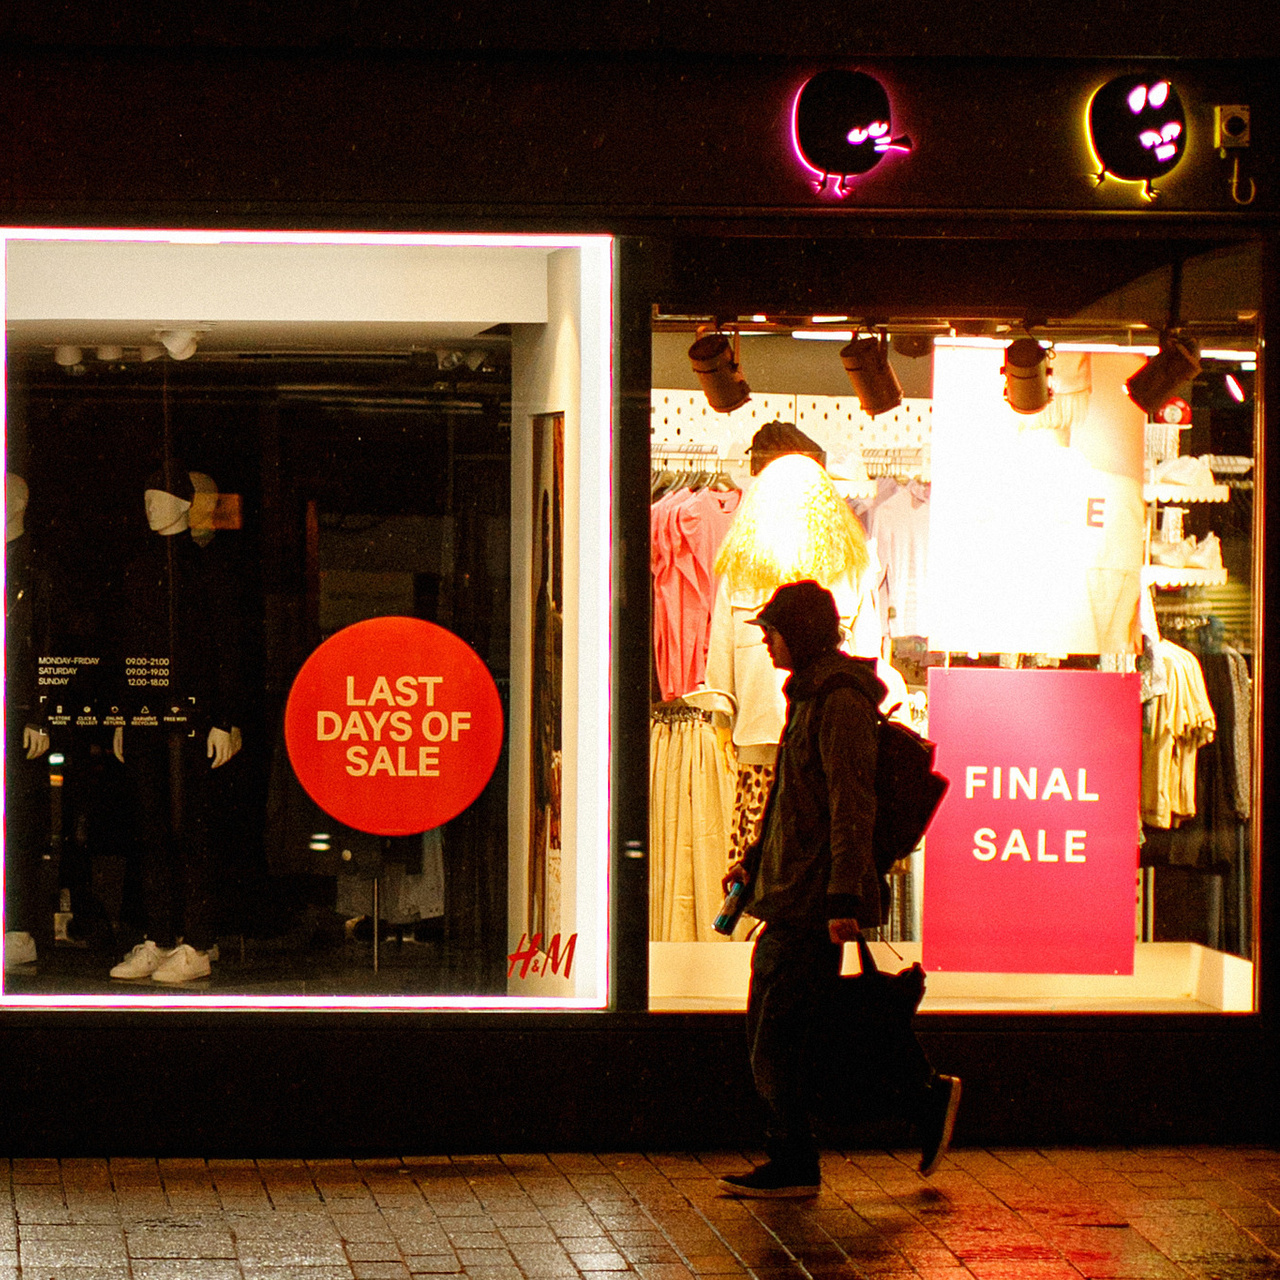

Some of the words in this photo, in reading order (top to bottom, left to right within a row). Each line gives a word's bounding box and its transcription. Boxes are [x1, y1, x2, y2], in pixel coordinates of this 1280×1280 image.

[38, 657, 100, 665] MONDAY-FRIDAY
[125, 657, 170, 665] 09.00-21.00
[38, 667, 78, 675] SATURDAY
[125, 668, 170, 676] 09.00-19.00
[38, 677, 69, 685] SUNDAY
[128, 678, 169, 686] 12.00-18.00
[346, 675, 443, 707] LAST
[317, 710, 413, 742] DAYS
[421, 711, 472, 742] OF
[345, 745, 440, 777] SALE
[965, 766, 1099, 801] FINAL
[972, 827, 1087, 863] SALE
[507, 933, 578, 979] H&M
